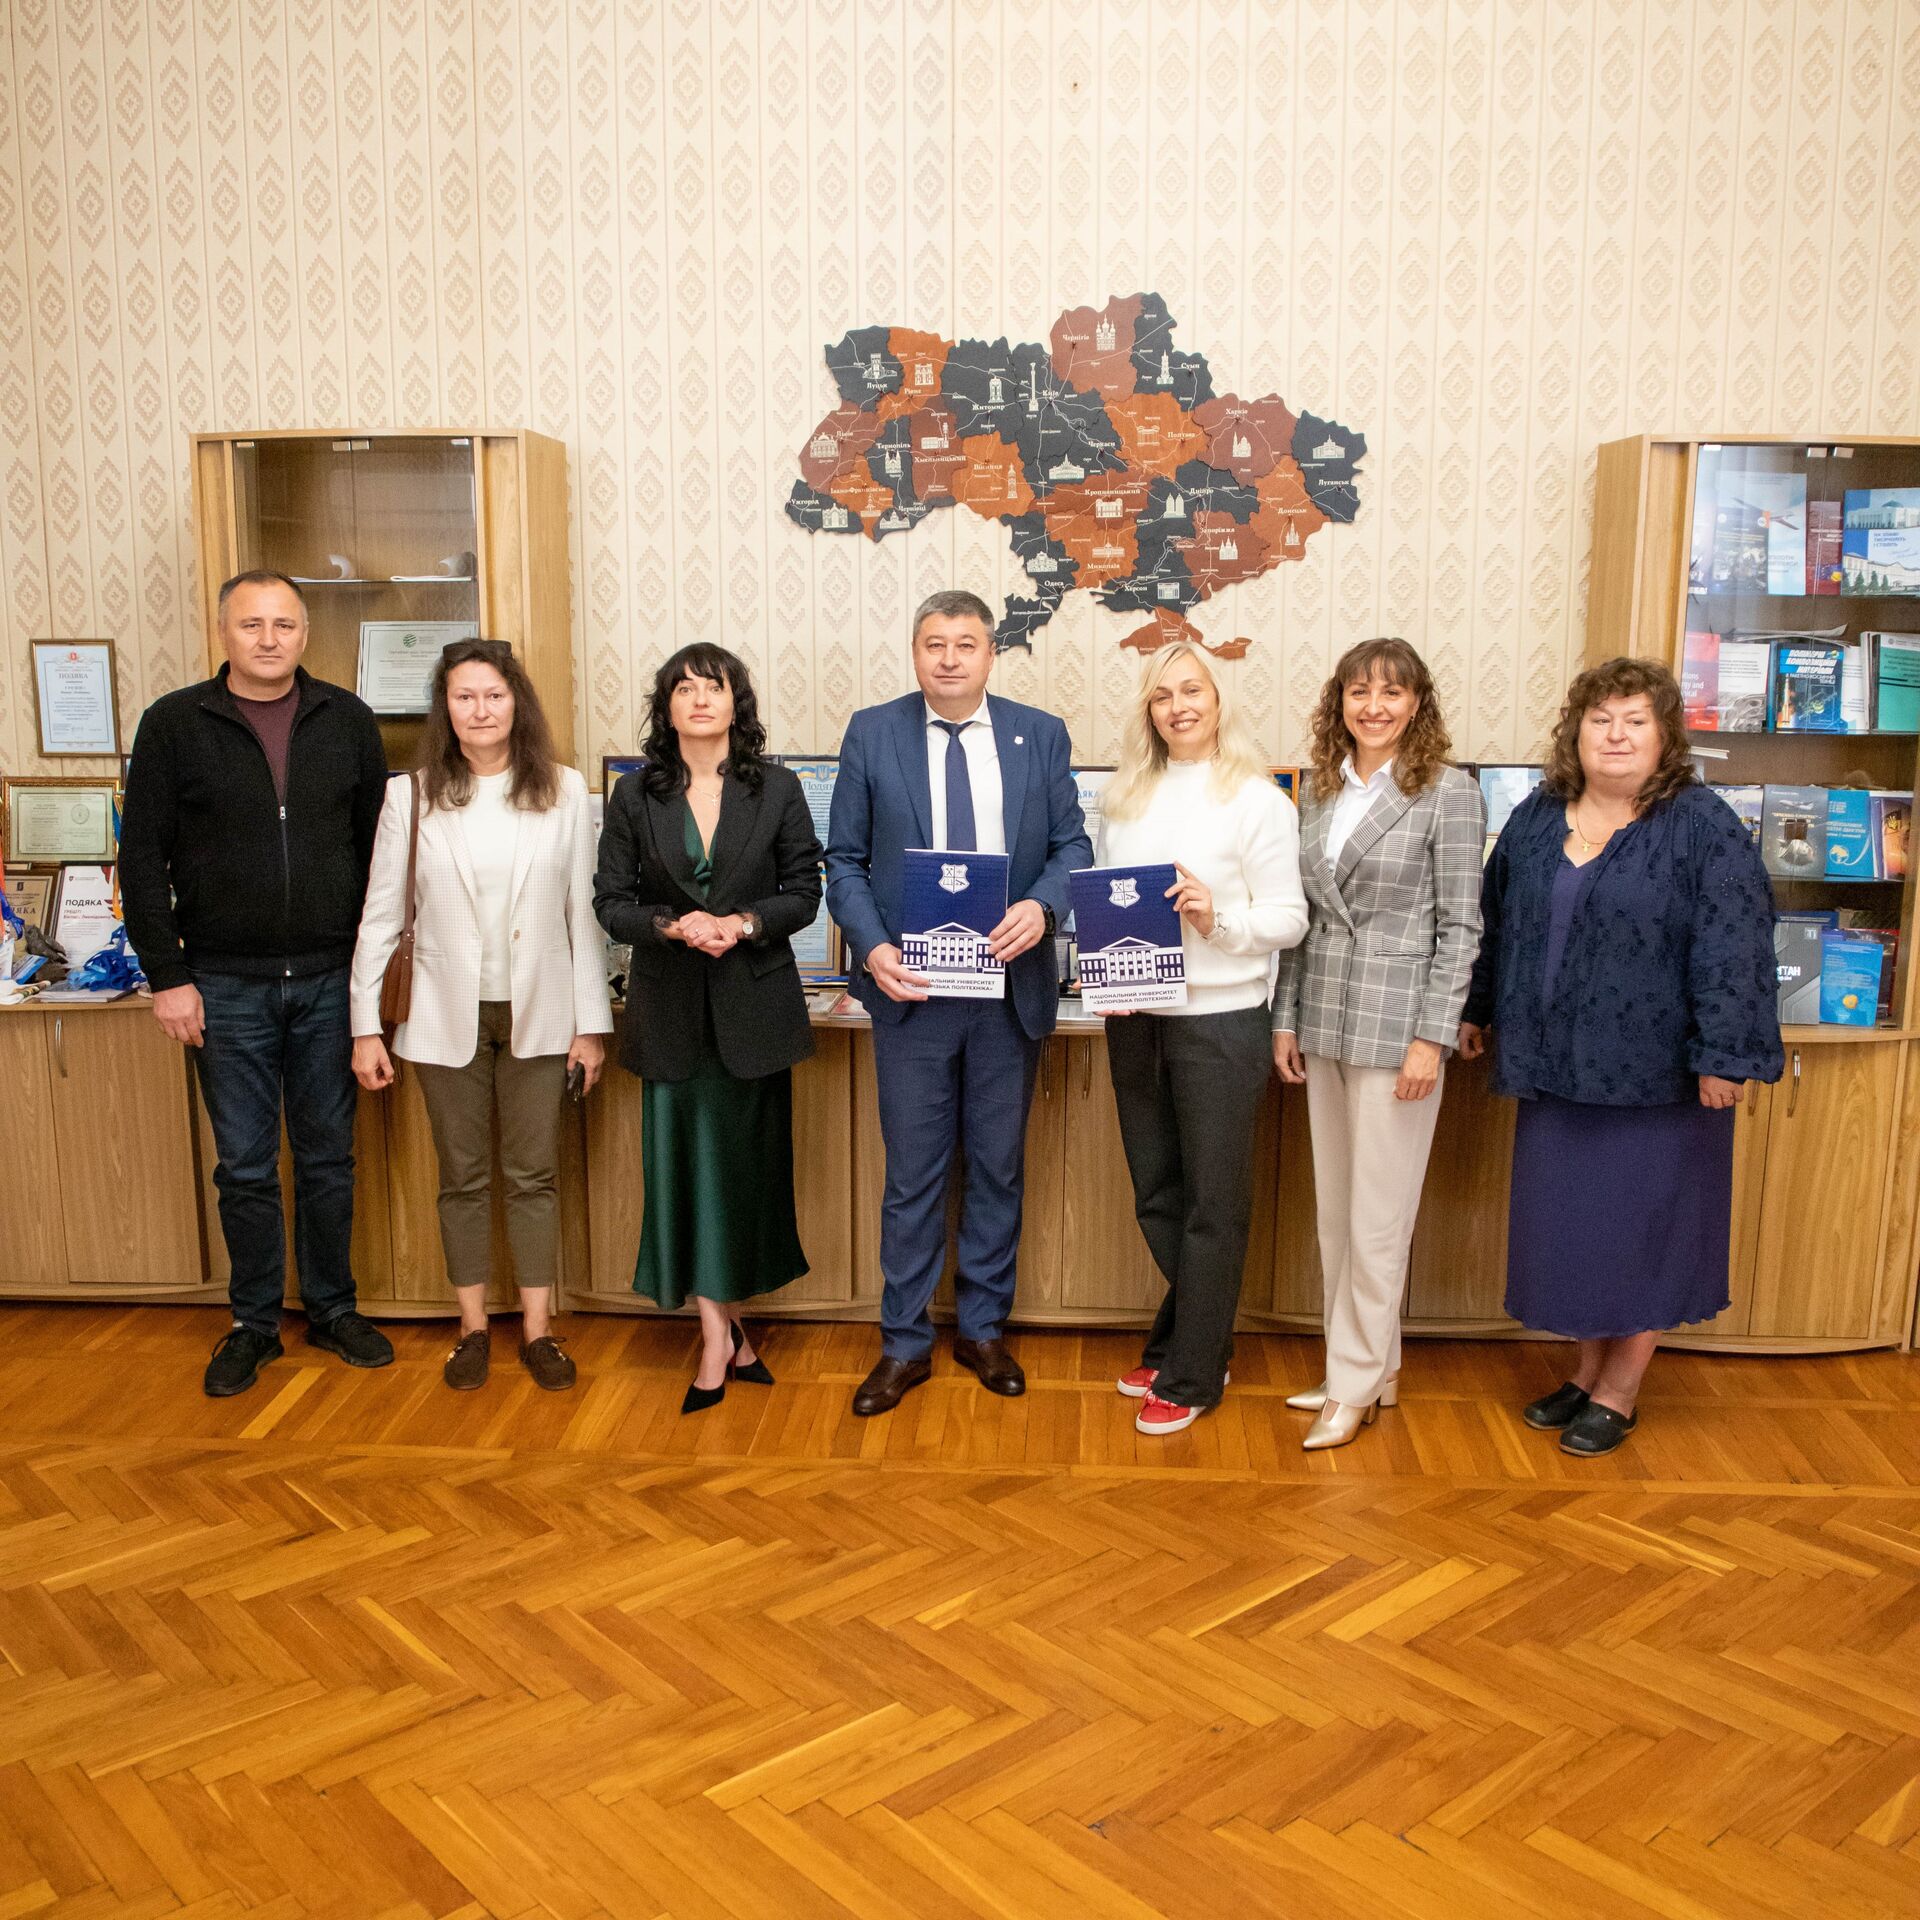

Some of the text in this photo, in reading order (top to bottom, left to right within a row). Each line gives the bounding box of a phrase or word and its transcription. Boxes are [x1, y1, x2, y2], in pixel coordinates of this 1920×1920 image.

[1063, 334, 1089, 343] Чернігів
[1181, 363, 1200, 371] Суми
[866, 382, 888, 393] Луцьк
[1042, 389, 1060, 398] Київ
[972, 404, 1005, 412] Житомир
[1225, 408, 1249, 416] Харків
[877, 442, 911, 450] Тернопіль
[1088, 440, 1115, 448] Черкаси
[1084, 488, 1140, 496] Кропивницький
[1189, 487, 1214, 496] Дніпро
[791, 499, 820, 508] Ужгород
[1278, 507, 1306, 515] Донецьк
[1200, 526, 1235, 534] Запоріжжя
[1087, 562, 1120, 570] Миколаїв
[1044, 580, 1064, 588] Одеса
[1124, 585, 1147, 593] Херсон
[65, 899, 103, 908] ПОДЯКА
